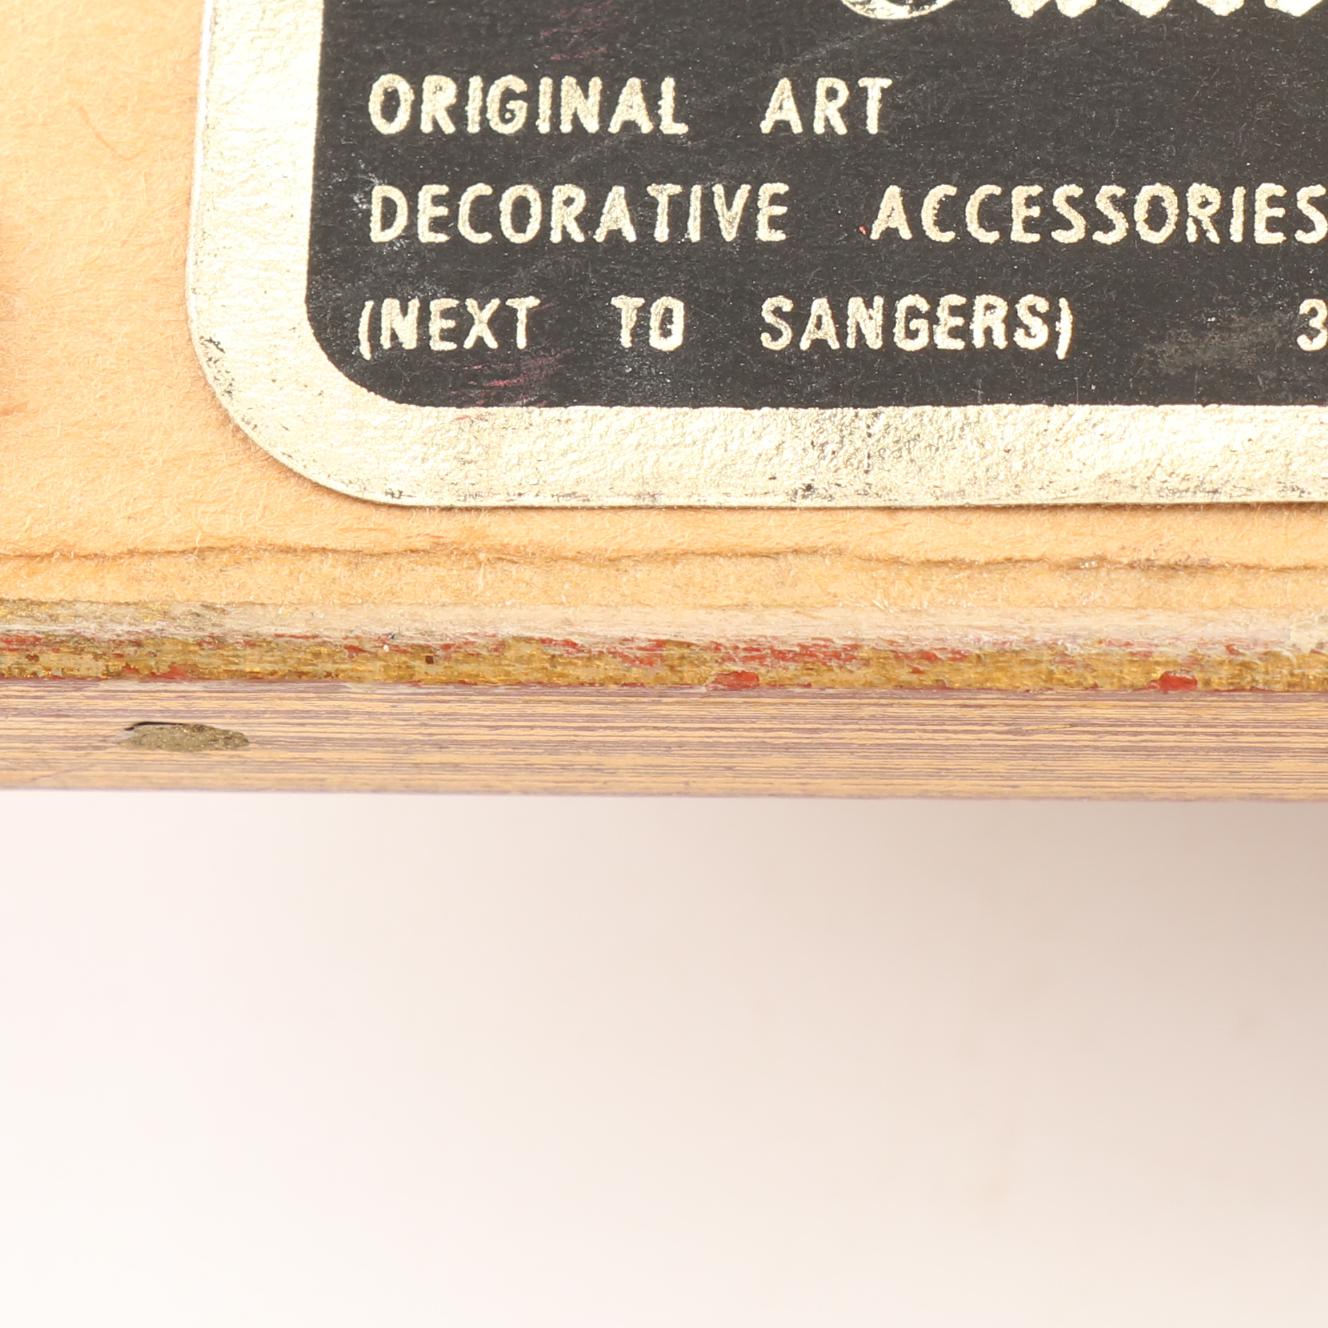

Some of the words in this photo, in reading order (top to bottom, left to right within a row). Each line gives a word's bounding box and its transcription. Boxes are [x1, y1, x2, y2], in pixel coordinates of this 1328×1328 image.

[368, 73, 689, 135] ORIGINAL
[760, 77, 892, 135] ART
[368, 182, 789, 246] DECORATIVE
[870, 182, 1328, 245] ACCESSORIES
[358, 296, 541, 360] (NEXT
[611, 295, 685, 353] TO
[760, 294, 1073, 360] SANGERS)
